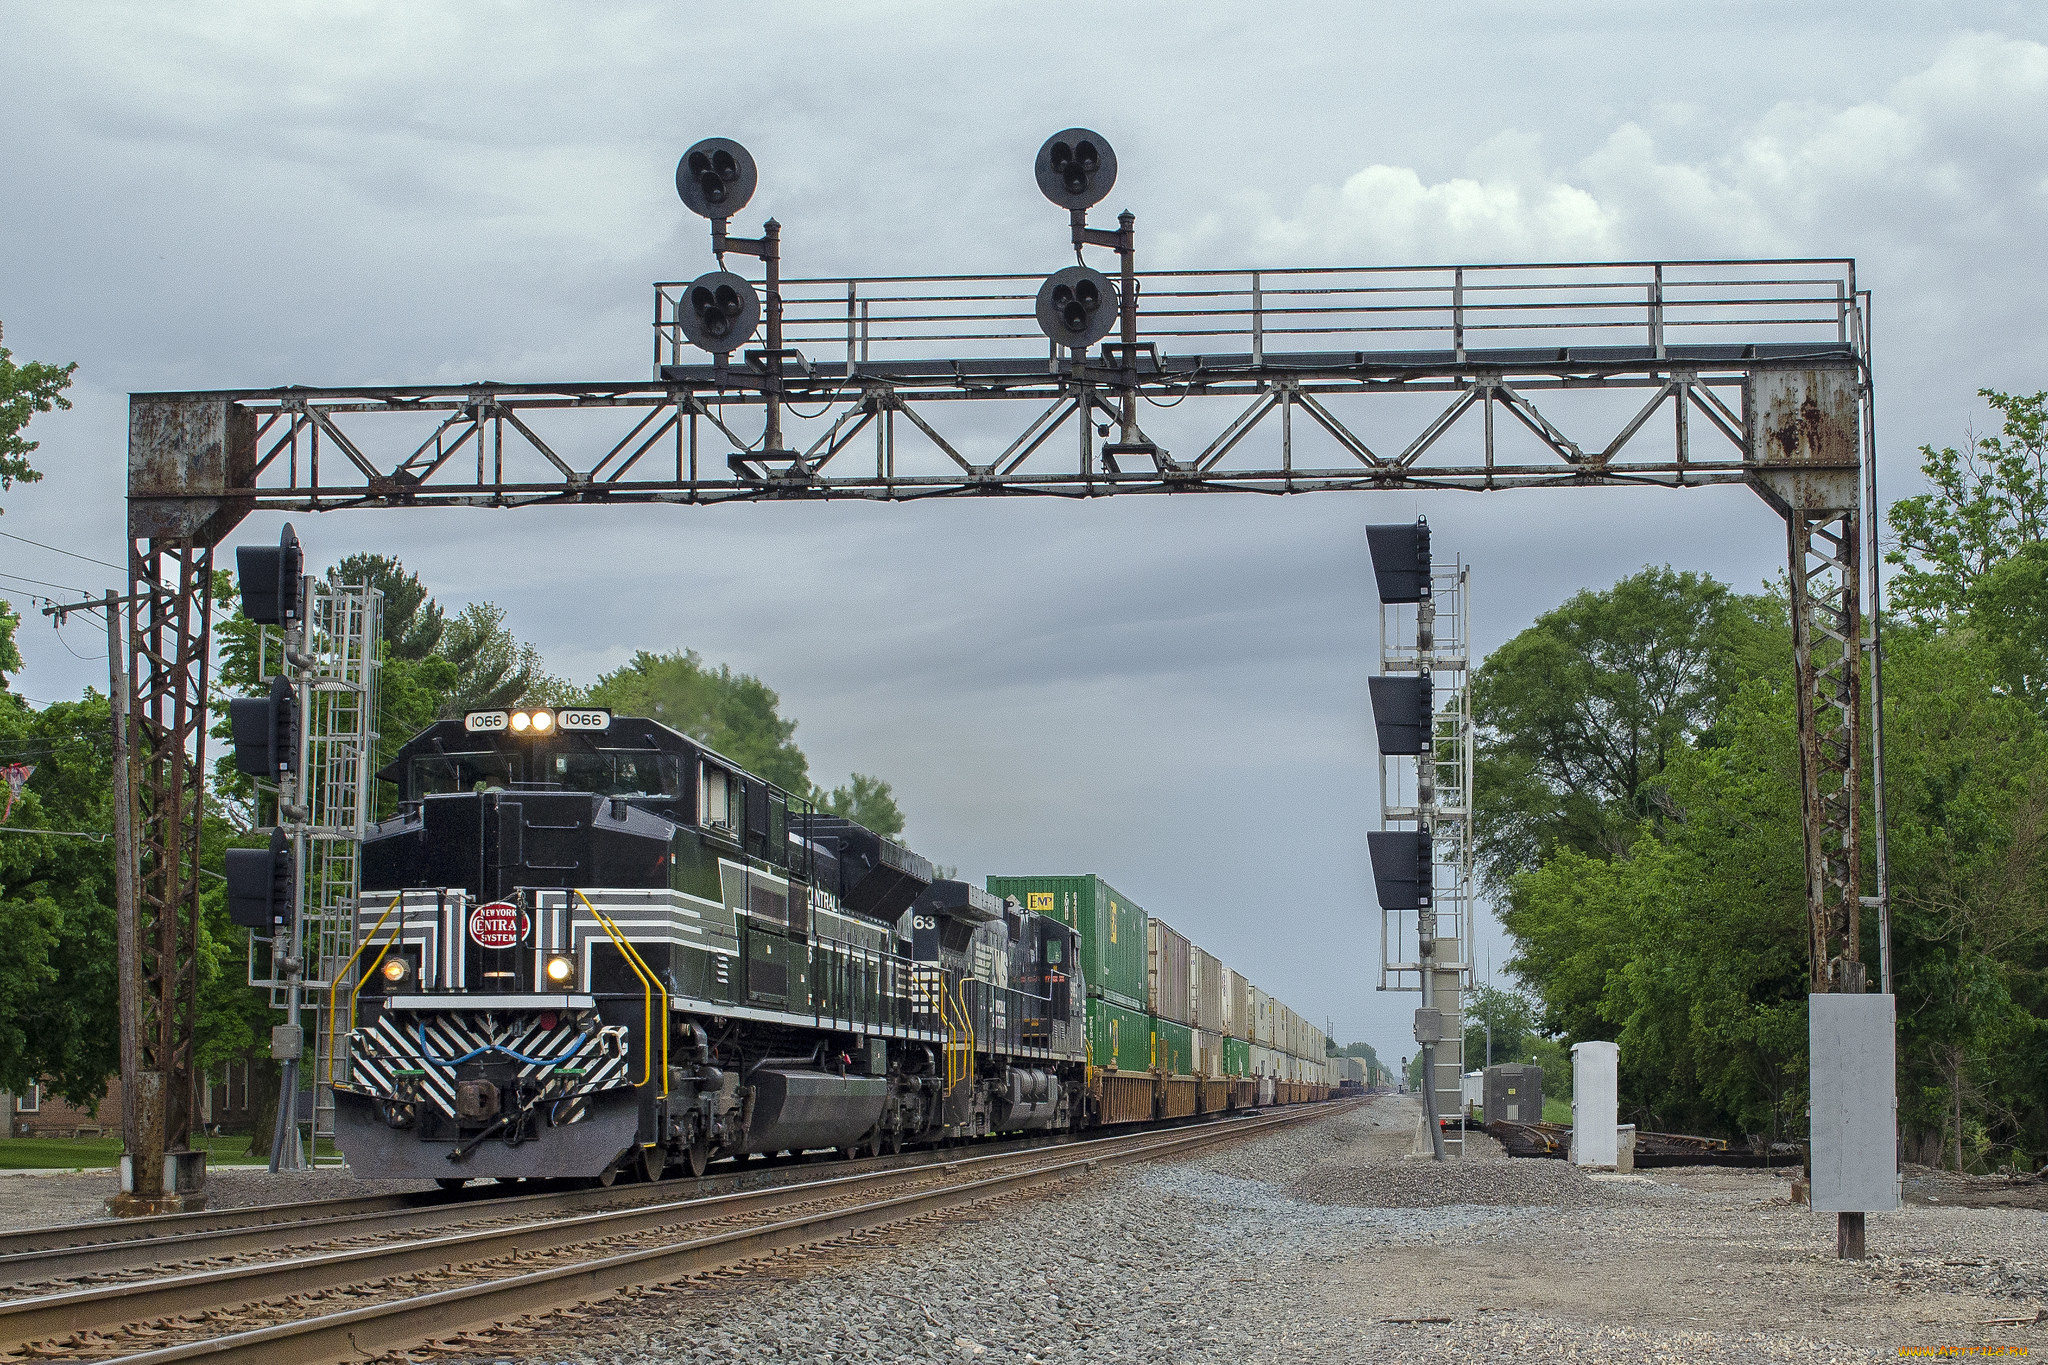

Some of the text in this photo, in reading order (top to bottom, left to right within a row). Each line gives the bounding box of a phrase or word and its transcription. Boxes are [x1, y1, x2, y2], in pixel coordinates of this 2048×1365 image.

[471, 715, 502, 728] 1066
[565, 713, 602, 726] 1066
[1030, 894, 1052, 909] EMP
[481, 909, 517, 917] NEW YORK
[473, 916, 527, 935] CENTRA
[481, 934, 517, 942] SYSTEM
